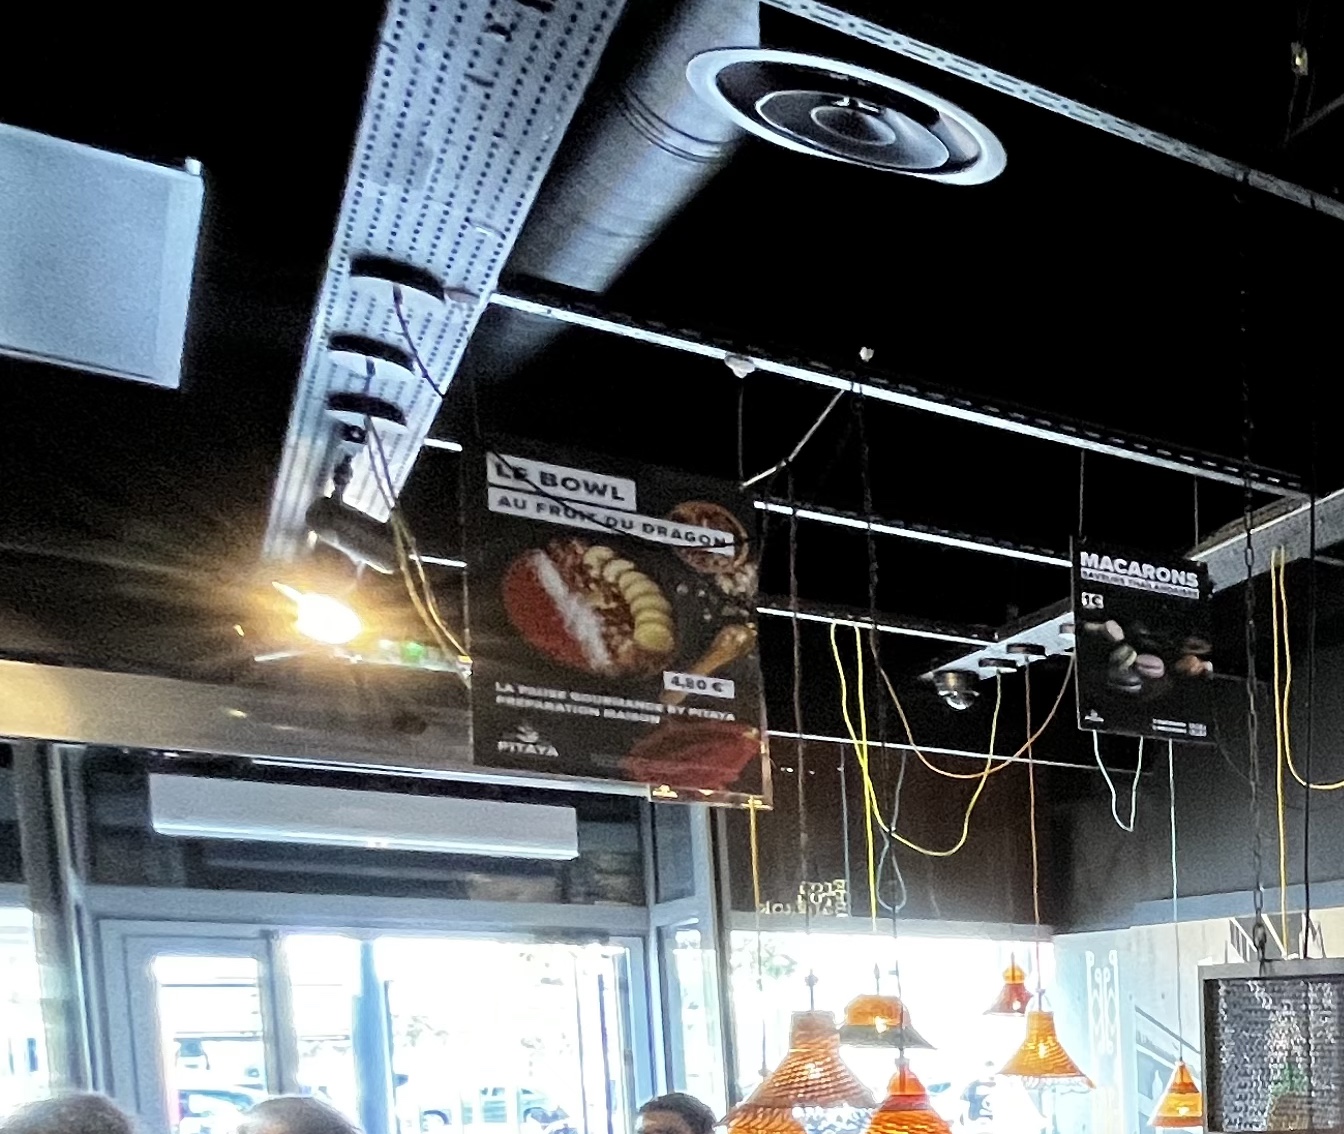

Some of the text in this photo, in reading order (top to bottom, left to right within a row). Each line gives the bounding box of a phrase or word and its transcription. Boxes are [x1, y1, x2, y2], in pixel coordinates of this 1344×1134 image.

[496, 462, 625, 501] LE BOWL
[498, 495, 527, 510] AU
[604, 516, 634, 529] DU
[642, 523, 726, 547] DRAGON
[1080, 551, 1199, 588] MACARONS
[495, 682, 515, 693] LA
[497, 741, 559, 757] PITAYA
